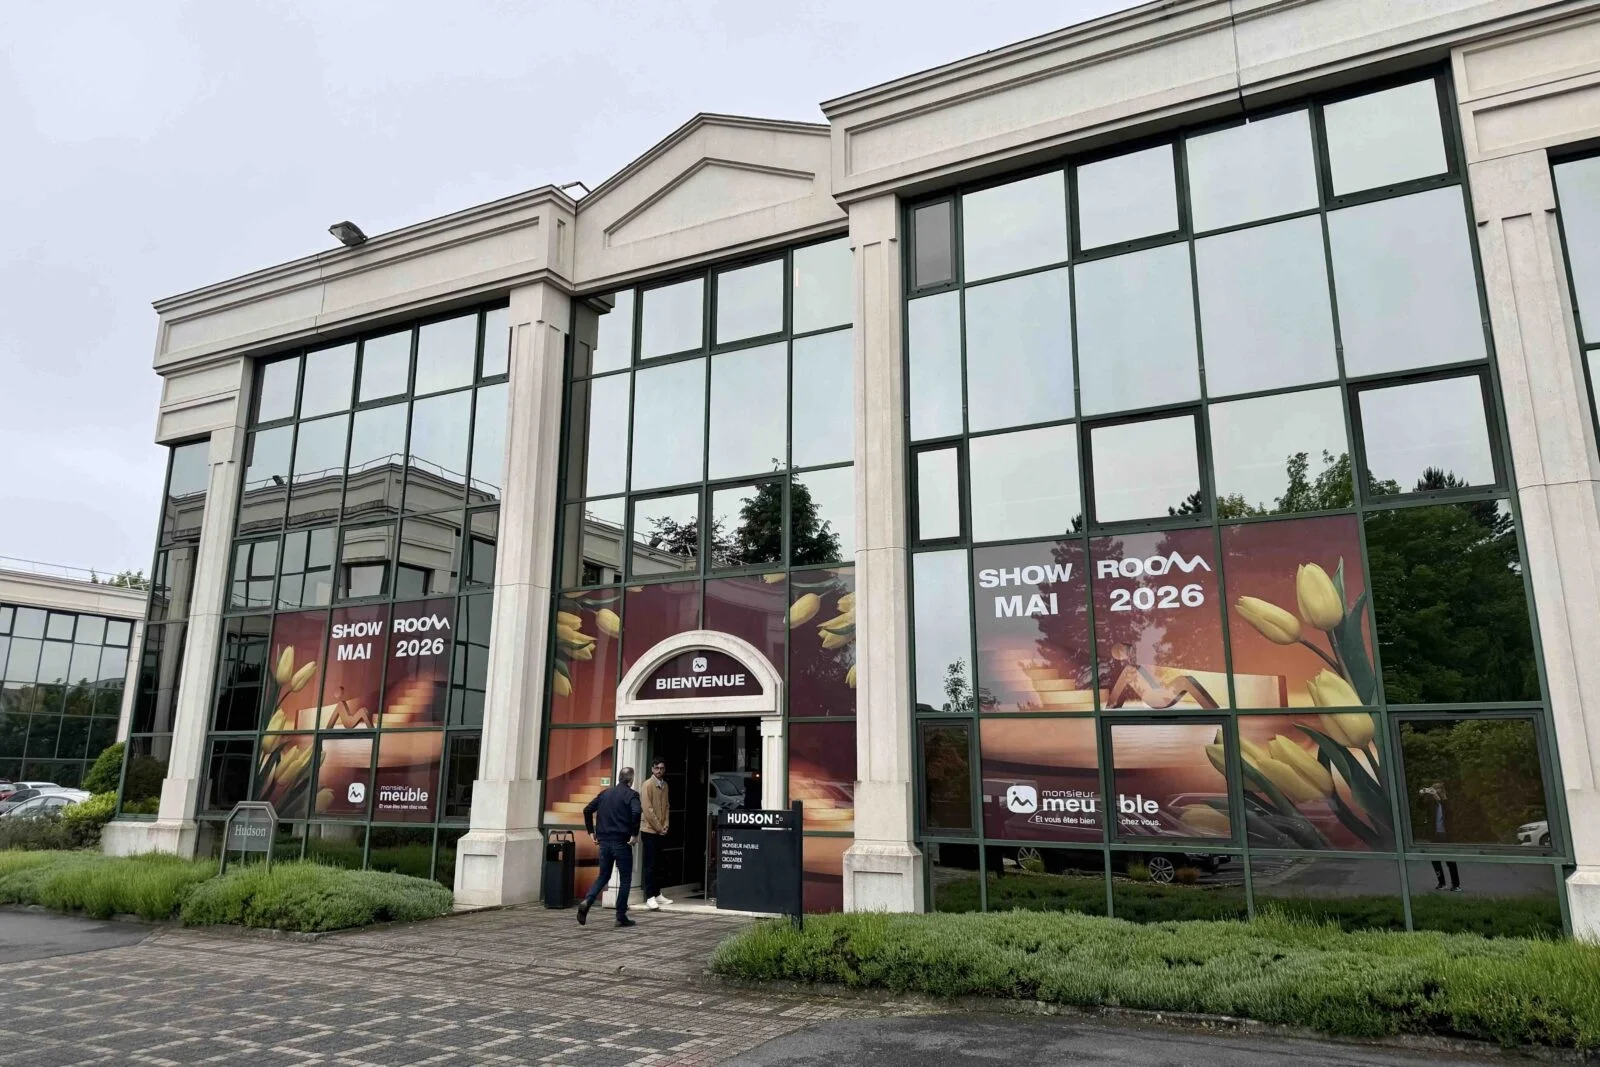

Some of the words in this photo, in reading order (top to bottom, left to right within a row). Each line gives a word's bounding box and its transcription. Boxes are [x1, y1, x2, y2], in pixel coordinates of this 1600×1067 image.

[978, 563, 1073, 588] SHOW
[1097, 551, 1212, 579] ROOM
[995, 592, 1058, 618] MAI
[1109, 584, 1205, 611] 2026
[332, 621, 382, 638] SHOW
[393, 614, 450, 633] ROOM
[337, 643, 372, 661] MAI
[395, 638, 444, 657] 2026
[656, 674, 745, 690] BIENVENUE
[380, 788, 428, 801] meuble
[1042, 789, 1095, 798] monsieur
[727, 813, 773, 824] HUDSON
[1035, 815, 1043, 823] Et
[1044, 816, 1061, 824] vous
[1062, 815, 1078, 824] êtes
[1080, 816, 1096, 825] bien
[1121, 818, 1139, 826] chez
[1141, 819, 1162, 827] vous.
[234, 824, 266, 837] Hudson
